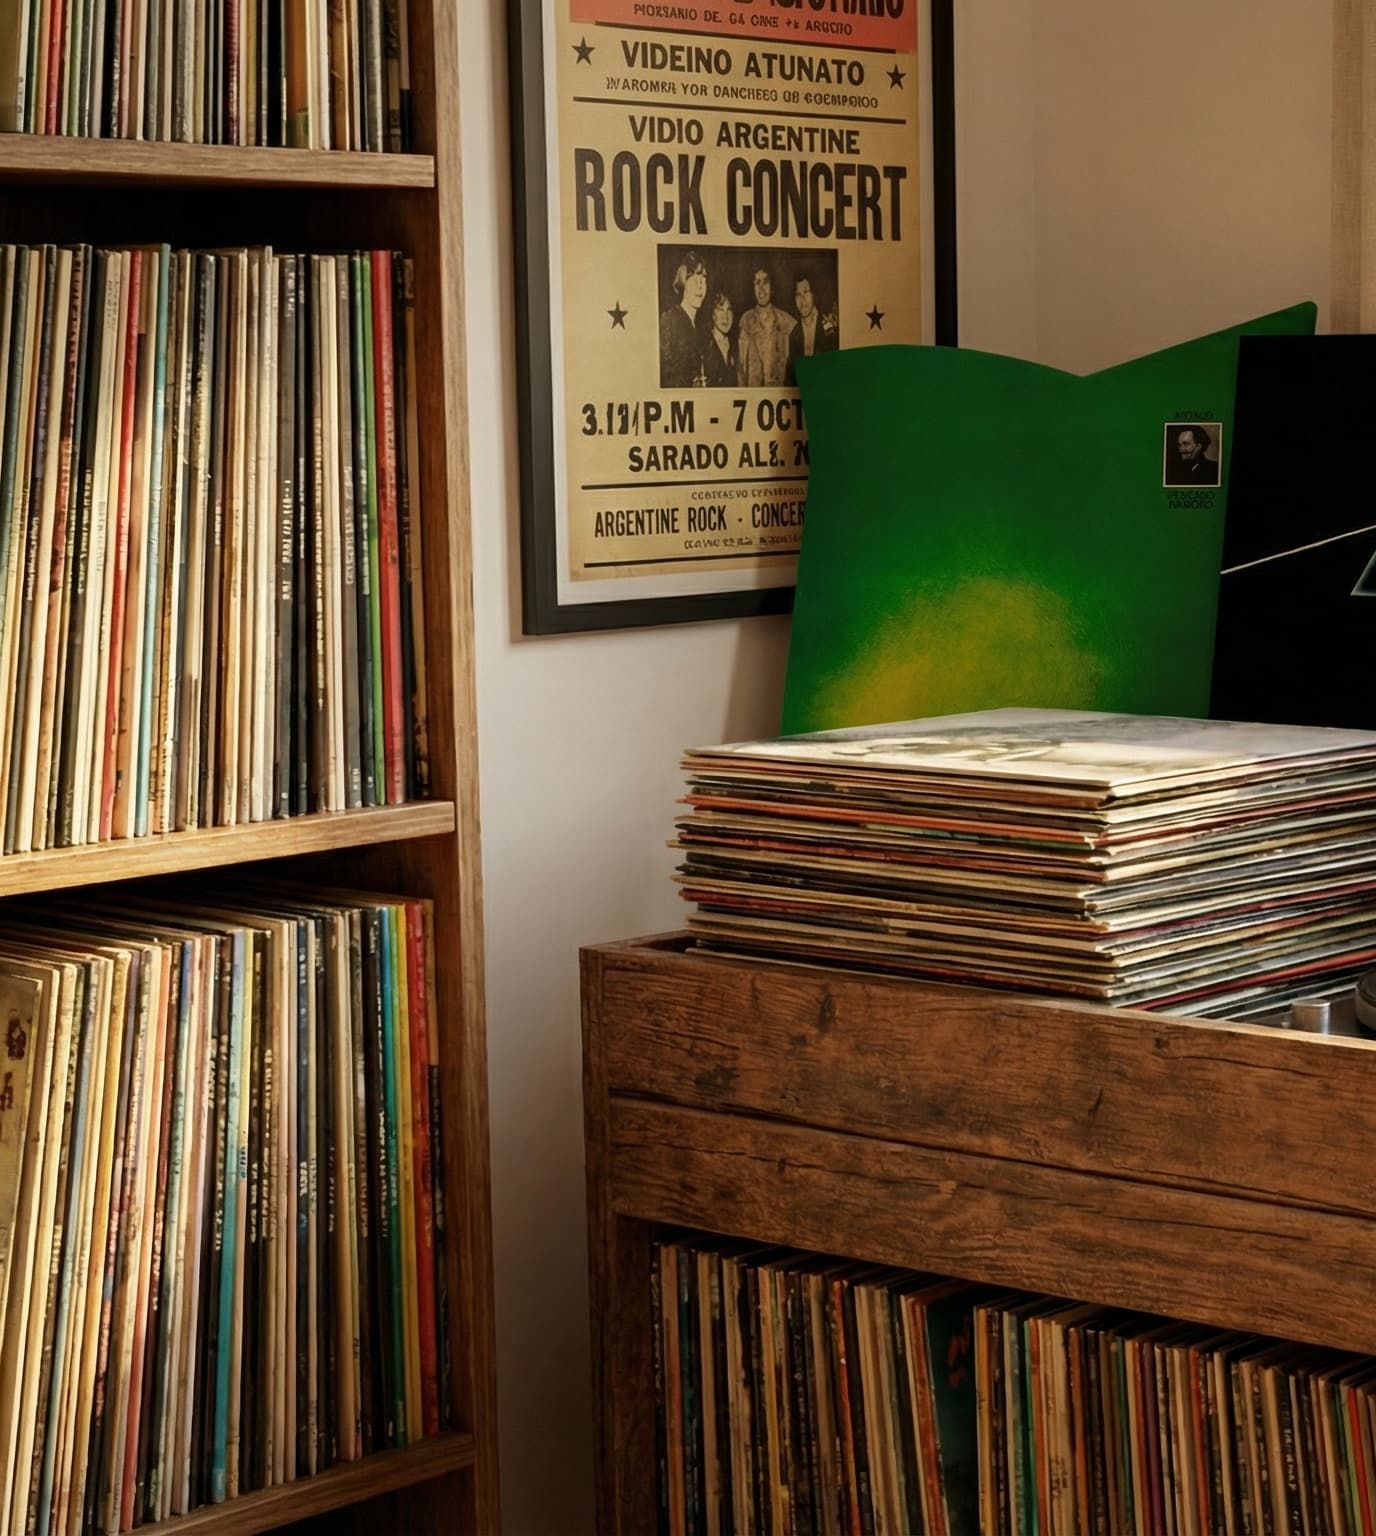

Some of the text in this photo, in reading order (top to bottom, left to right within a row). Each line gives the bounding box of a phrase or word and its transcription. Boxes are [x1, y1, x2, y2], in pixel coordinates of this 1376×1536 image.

[621, 40, 865, 86] VIDEINO ATUNATO
[628, 115, 860, 154] VIDIO ARGENTINE
[574, 148, 907, 241] ROCK CONCERT
[733, 400, 747, 432] 7
[629, 442, 728, 472] SARADO
[594, 507, 680, 538] ARGENTINE
[688, 505, 727, 532] ROCK
